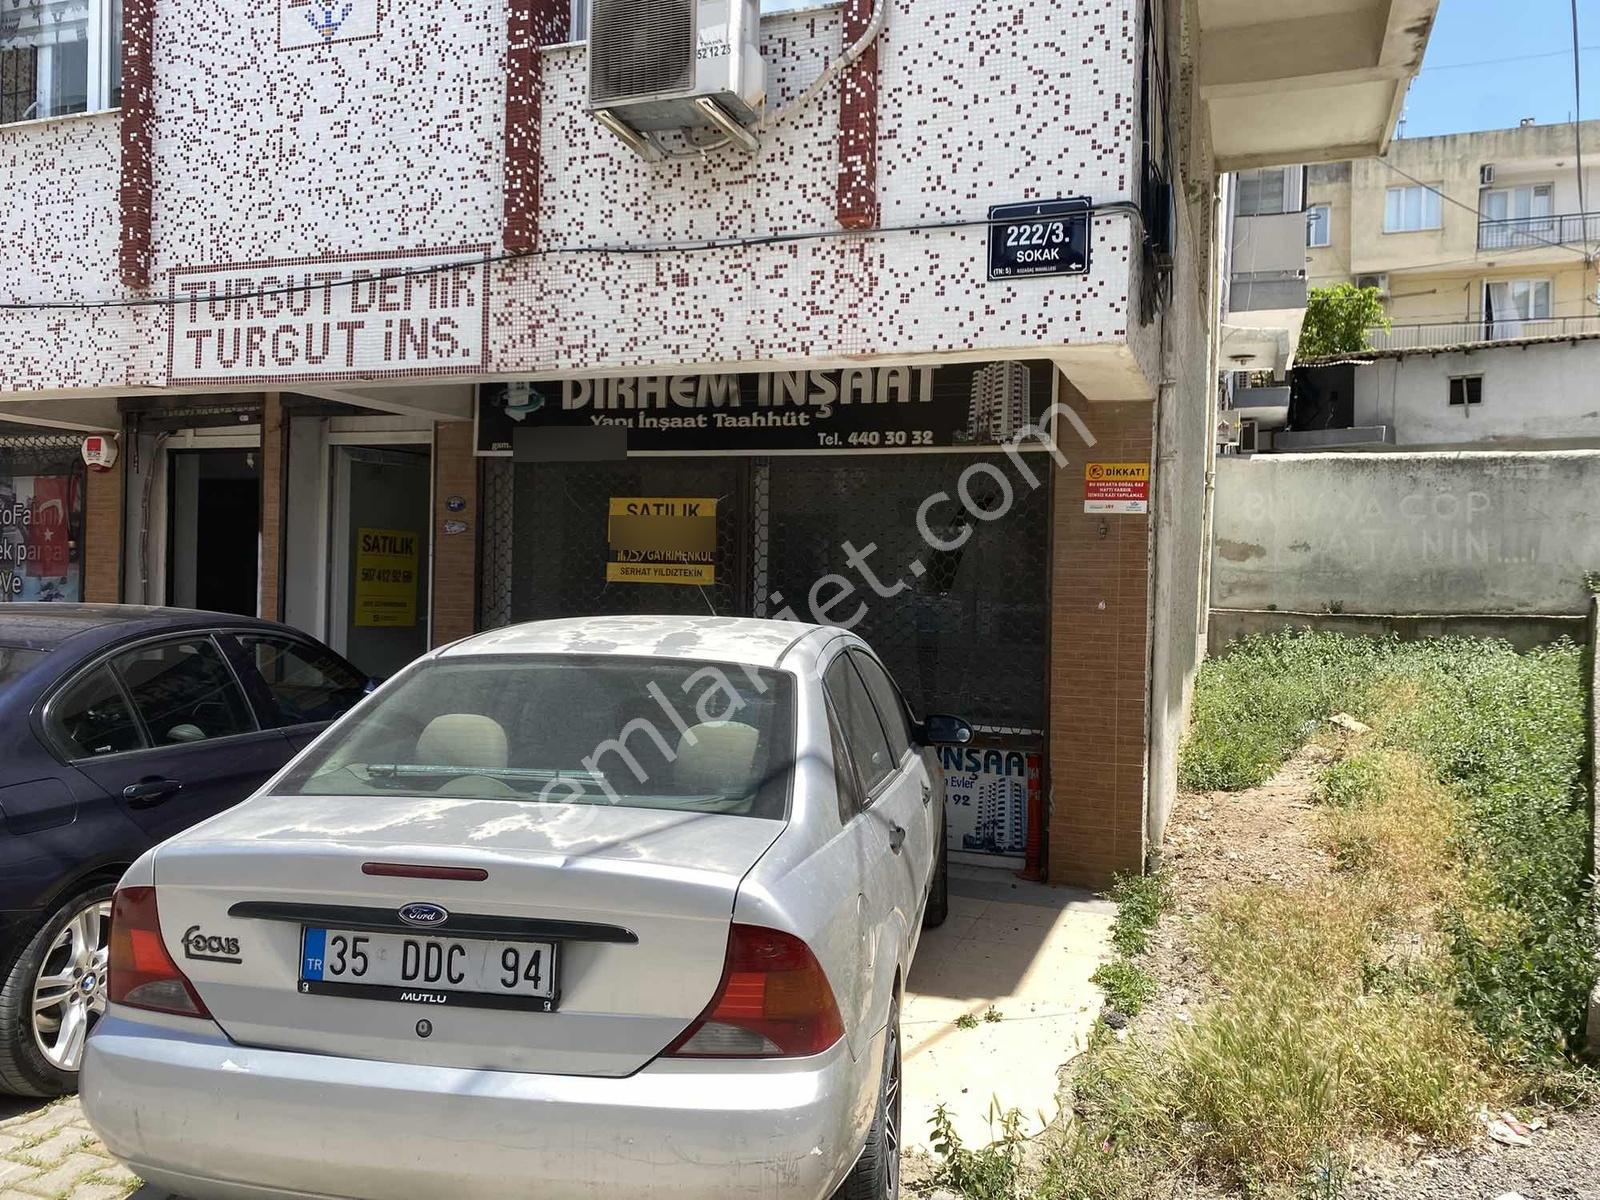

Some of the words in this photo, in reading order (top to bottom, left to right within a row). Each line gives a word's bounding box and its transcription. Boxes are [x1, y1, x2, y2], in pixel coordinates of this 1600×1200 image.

[1007, 222, 1069, 246] 222/3.
[1016, 247, 1060, 263] SOKAK
[181, 271, 343, 323] TURGUT
[186, 320, 365, 370] TURGUT
[638, 410, 708, 431] İnşaat
[712, 410, 811, 428] Taahhüt
[817, 431, 843, 446] Tel.
[847, 431, 881, 446] 440
[884, 430, 907, 445] 30
[911, 430, 934, 445] 32
[1106, 467, 1145, 476] DİKKAT!
[362, 534, 414, 555] SATILIK
[619, 567, 652, 576] SERHAT
[1, 571, 22, 594] Ve
[950, 776, 976, 789] Evler
[952, 794, 971, 806] 92
[408, 907, 438, 921] Ford
[306, 957, 322, 971] TR
[329, 935, 370, 977] 35
[402, 939, 466, 985] DDC
[500, 947, 542, 991] 94
[400, 991, 447, 1004] MUTLU
